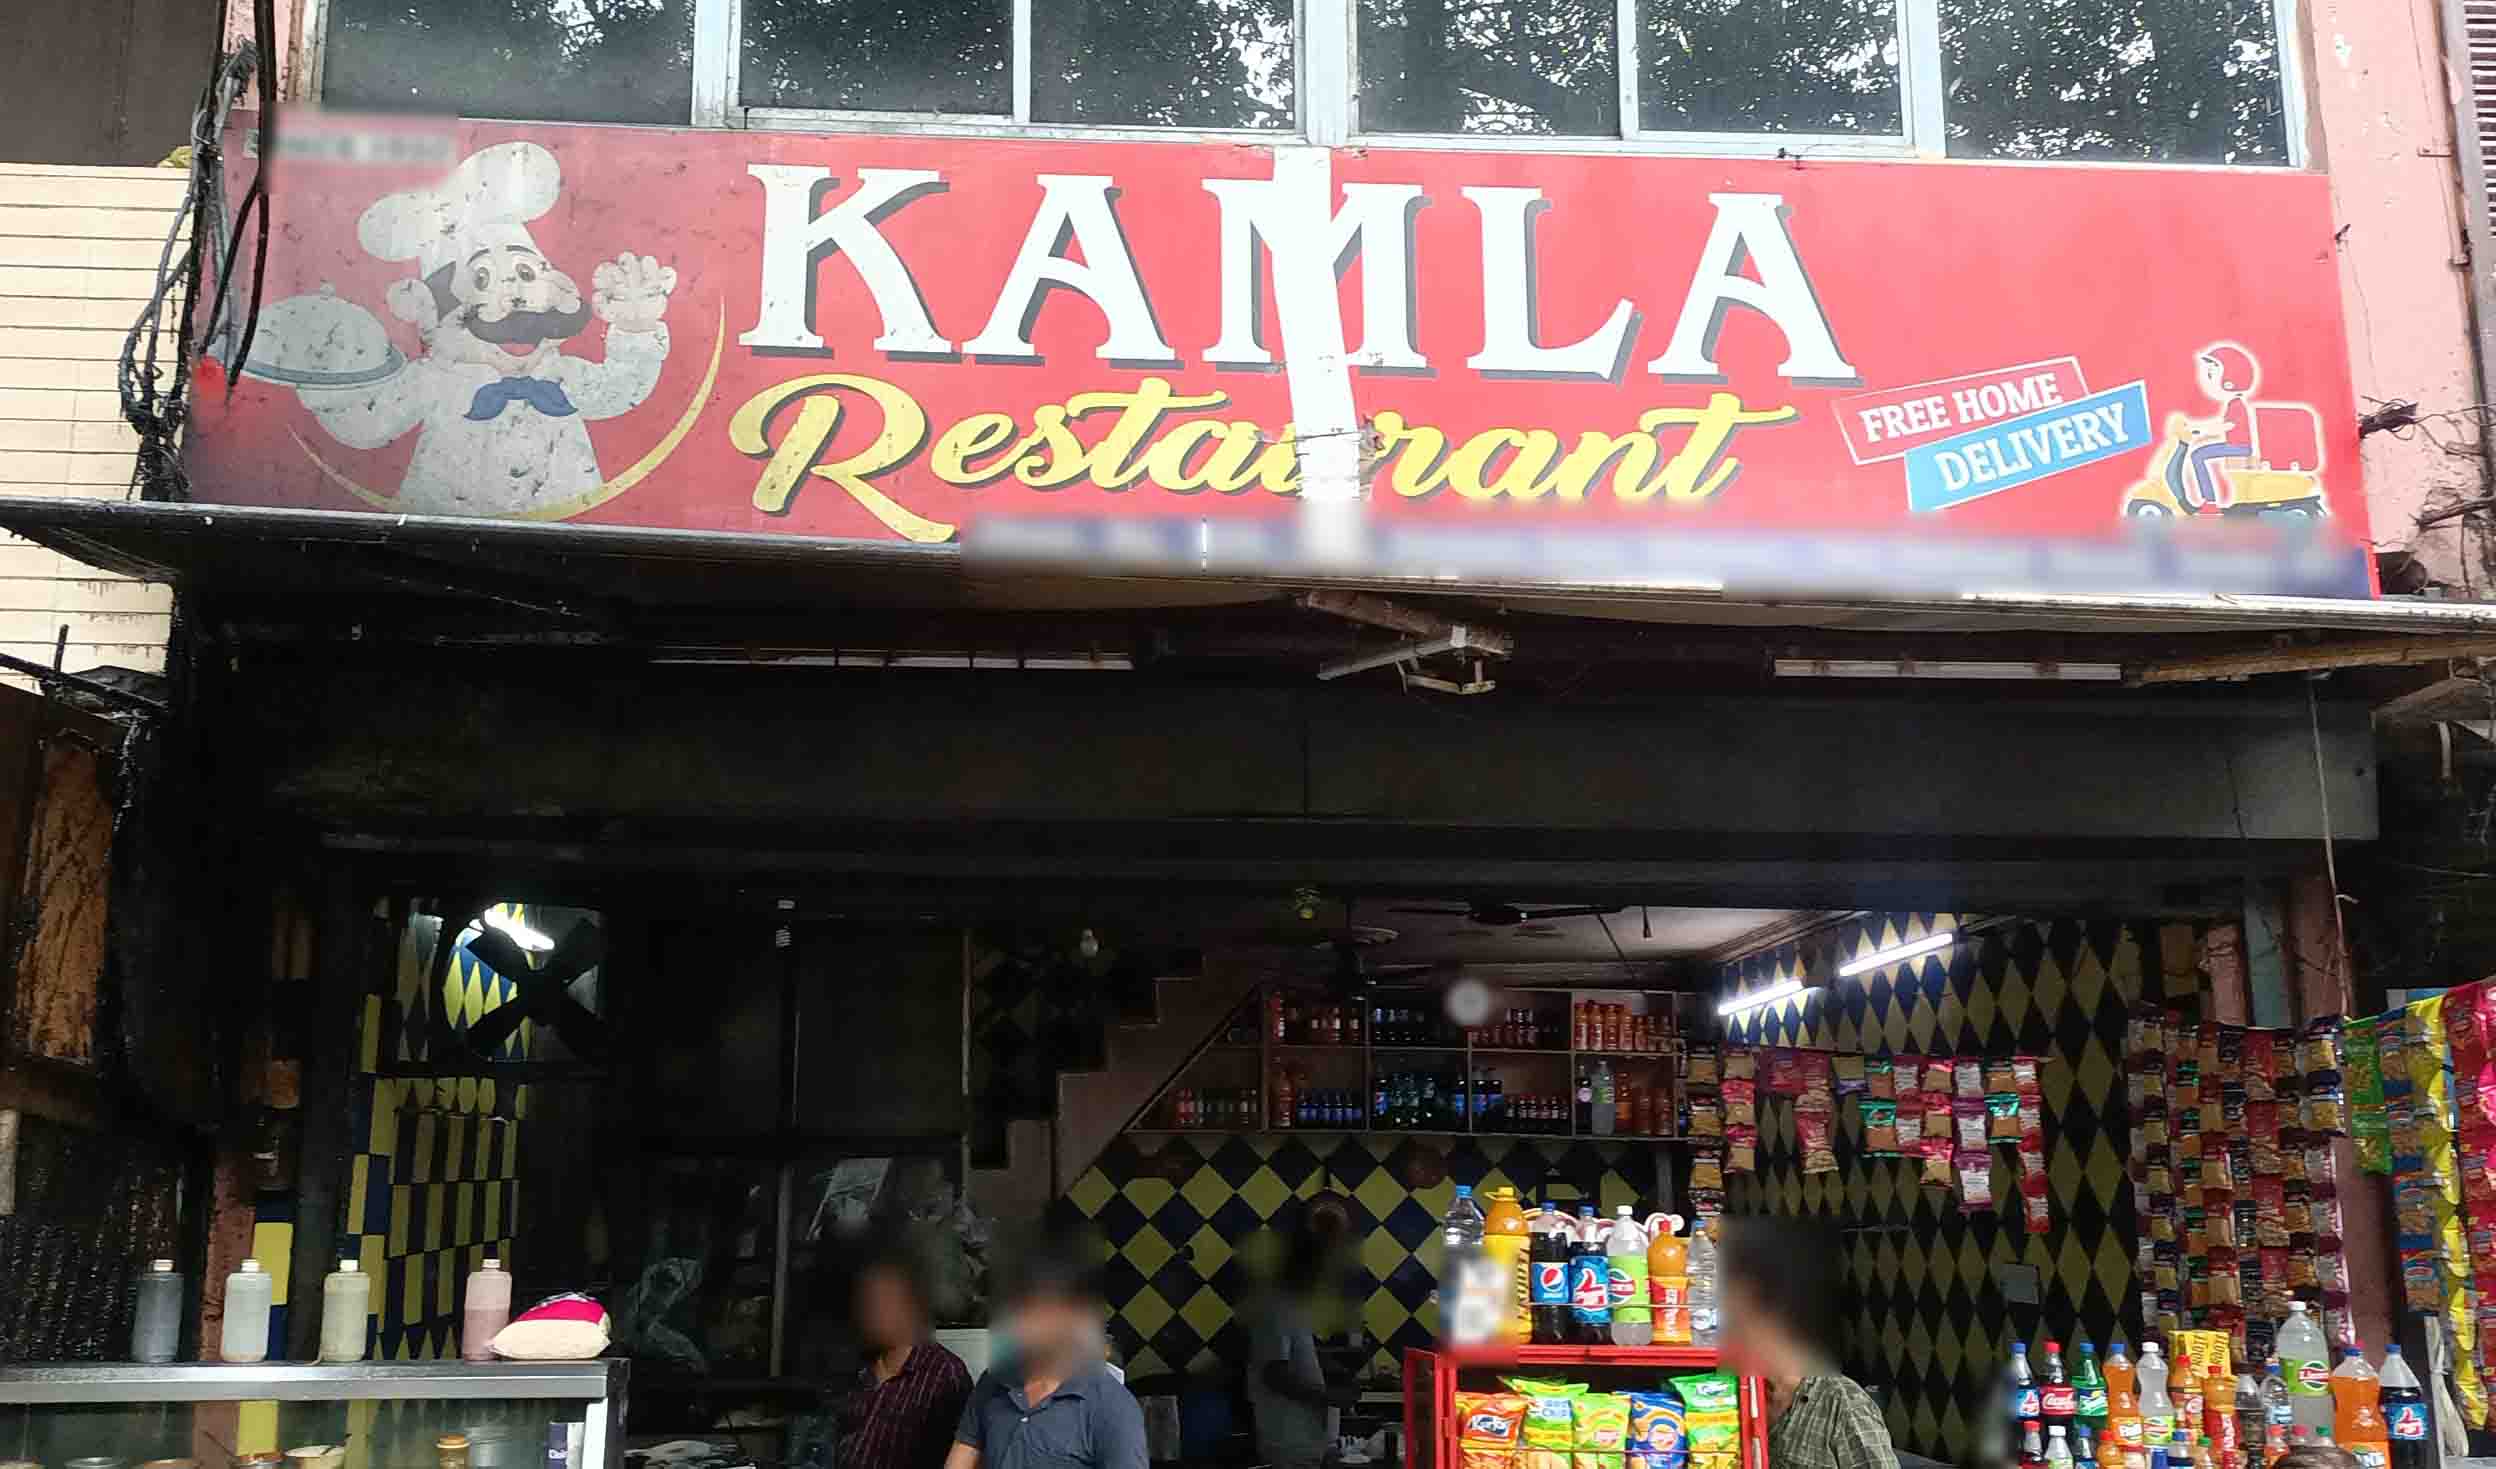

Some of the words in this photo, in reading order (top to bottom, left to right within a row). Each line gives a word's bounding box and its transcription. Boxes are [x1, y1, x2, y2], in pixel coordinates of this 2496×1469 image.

[738, 163, 1860, 384] KAMLA
[1857, 395, 1952, 443] FREE
[1951, 372, 2063, 424] HOME
[1934, 401, 2130, 491] DELIVERY
